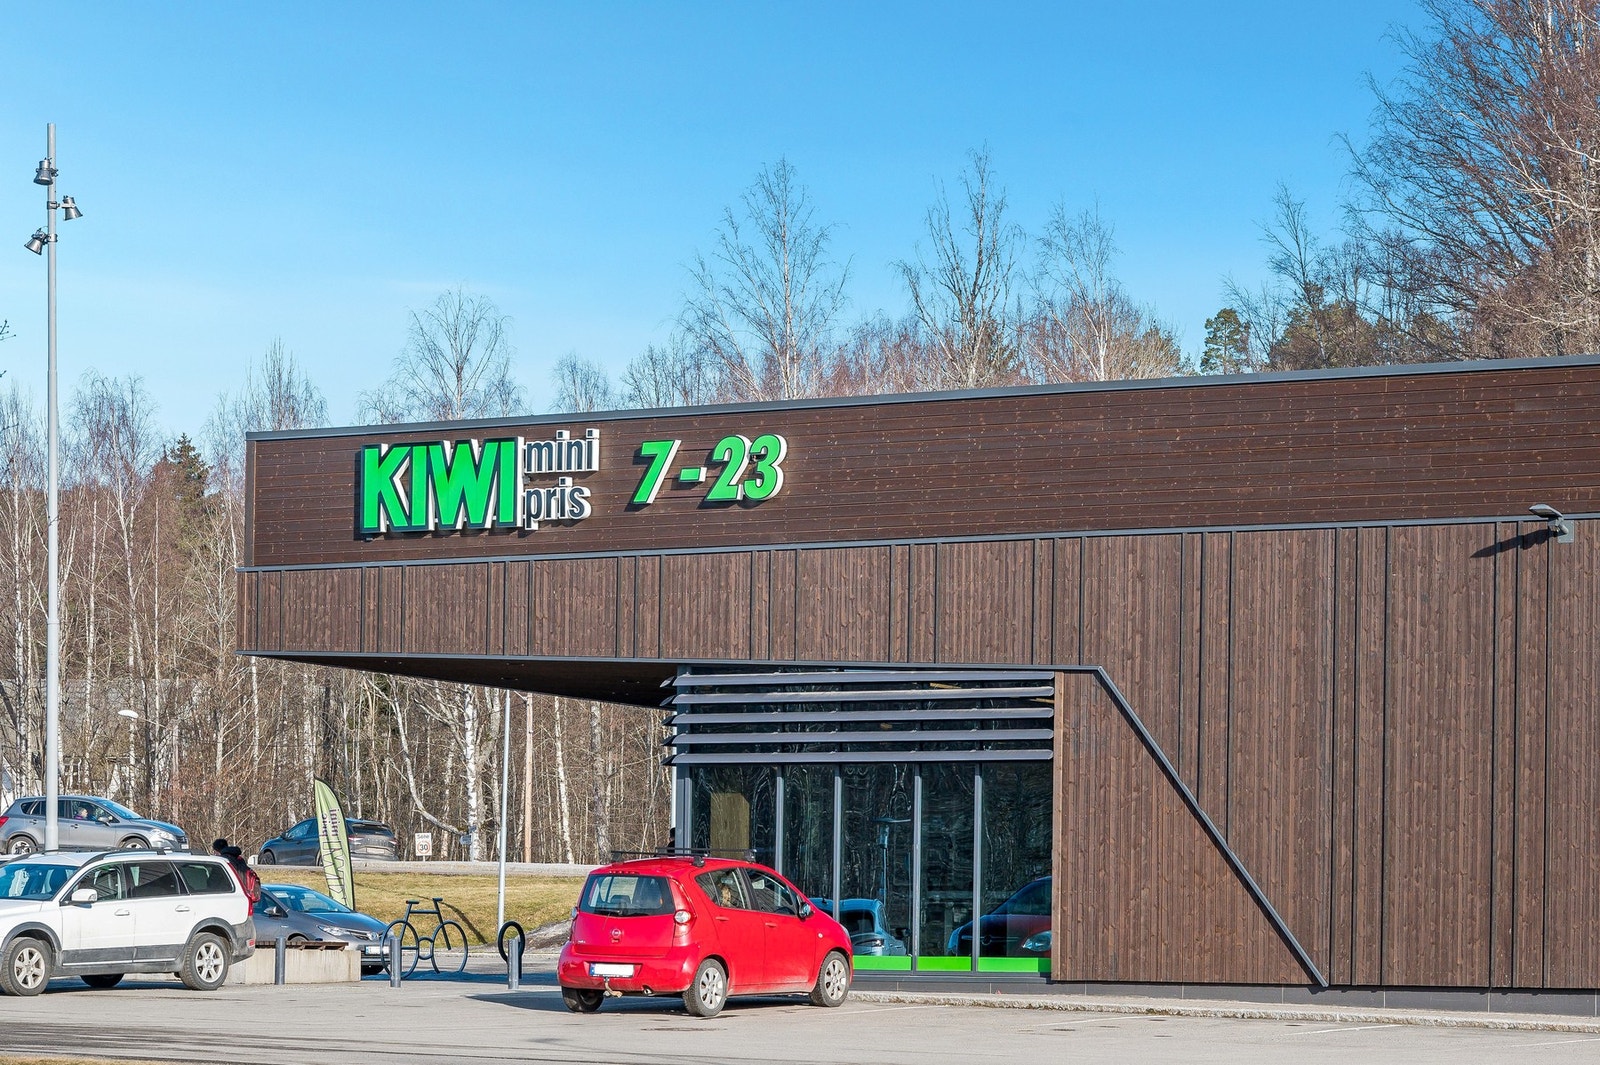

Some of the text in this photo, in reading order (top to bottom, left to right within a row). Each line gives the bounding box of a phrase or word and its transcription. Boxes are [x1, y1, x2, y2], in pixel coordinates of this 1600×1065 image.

[524, 428, 600, 473] mini
[361, 436, 525, 533] KIWI
[524, 476, 592, 531] pris
[419, 843, 429, 851] 30
